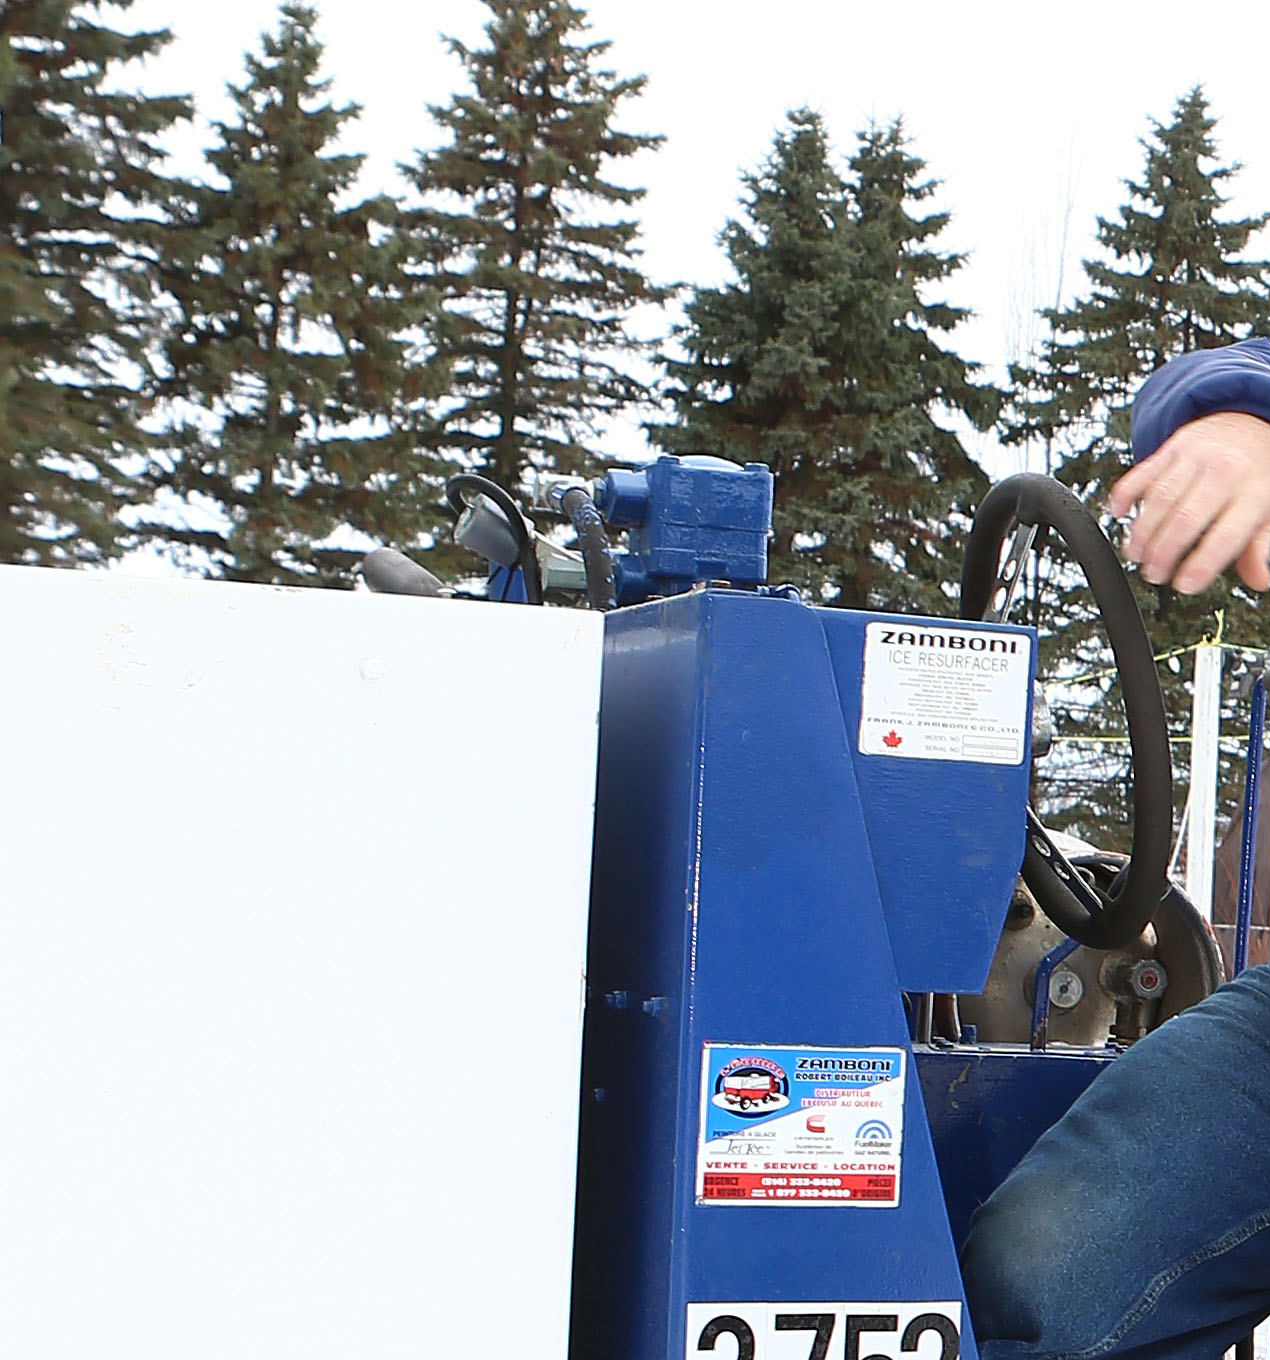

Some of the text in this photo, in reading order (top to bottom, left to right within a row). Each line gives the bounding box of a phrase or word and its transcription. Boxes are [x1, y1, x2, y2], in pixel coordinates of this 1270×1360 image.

[880, 630, 1017, 654] ZAMBONI
[889, 649, 1009, 672] ICE RESURFACER
[796, 1057, 892, 1071] ZAMBONI
[795, 1073, 832, 1082] ROBERT
[834, 1074, 873, 1082] BOILEAU
[814, 1088, 871, 1098] DISTRIBUTEUR
[706, 1161, 748, 1170] VENTE
[763, 1162, 818, 1170] SERVICE
[834, 1163, 895, 1171] LOCATION
